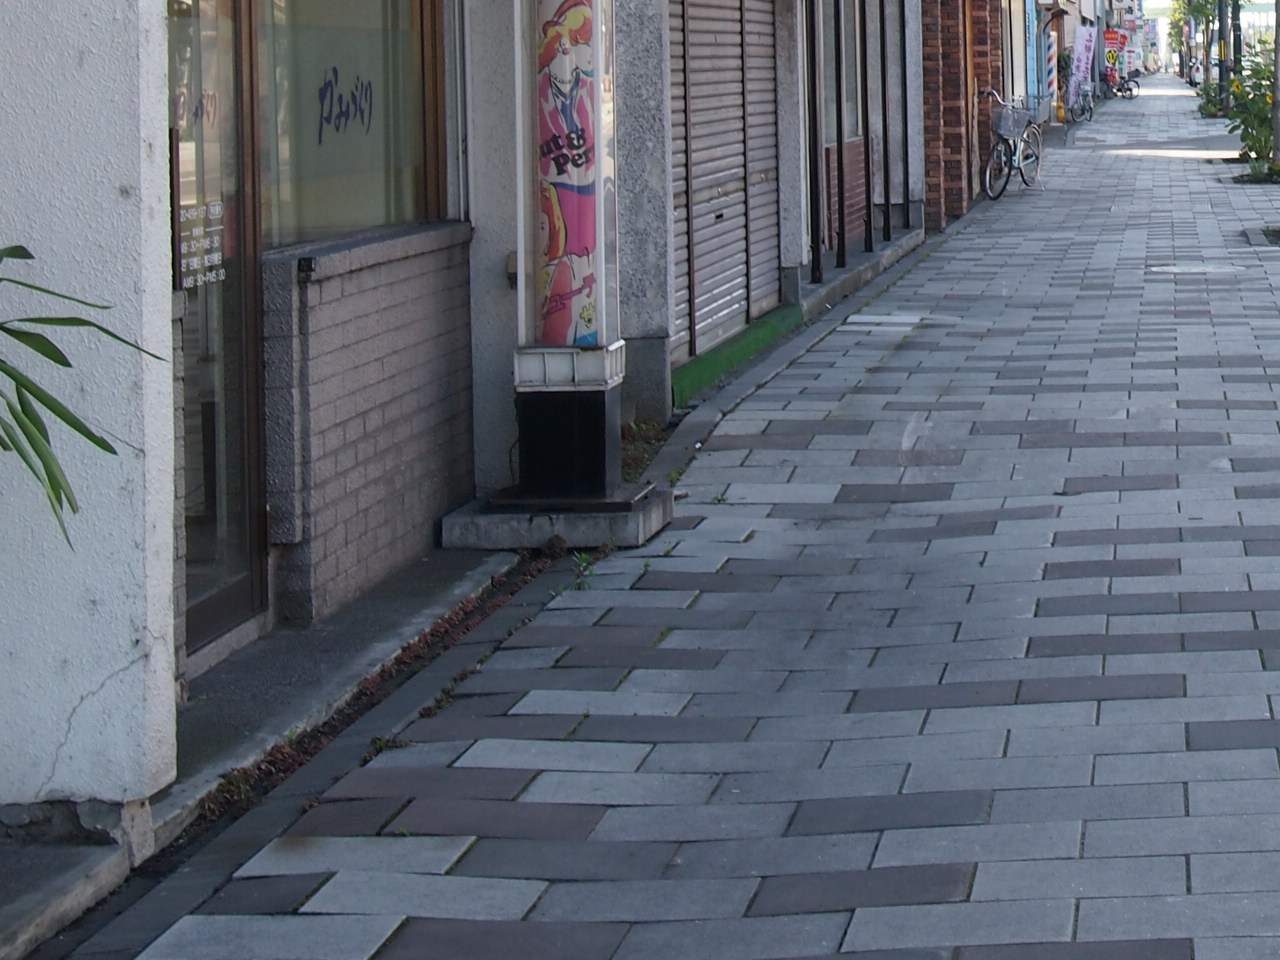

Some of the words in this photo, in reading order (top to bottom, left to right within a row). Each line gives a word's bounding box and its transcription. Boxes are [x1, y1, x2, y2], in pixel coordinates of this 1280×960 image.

[539, 133, 566, 158] ut
[565, 127, 587, 151] &
[551, 148, 594, 177] Per
